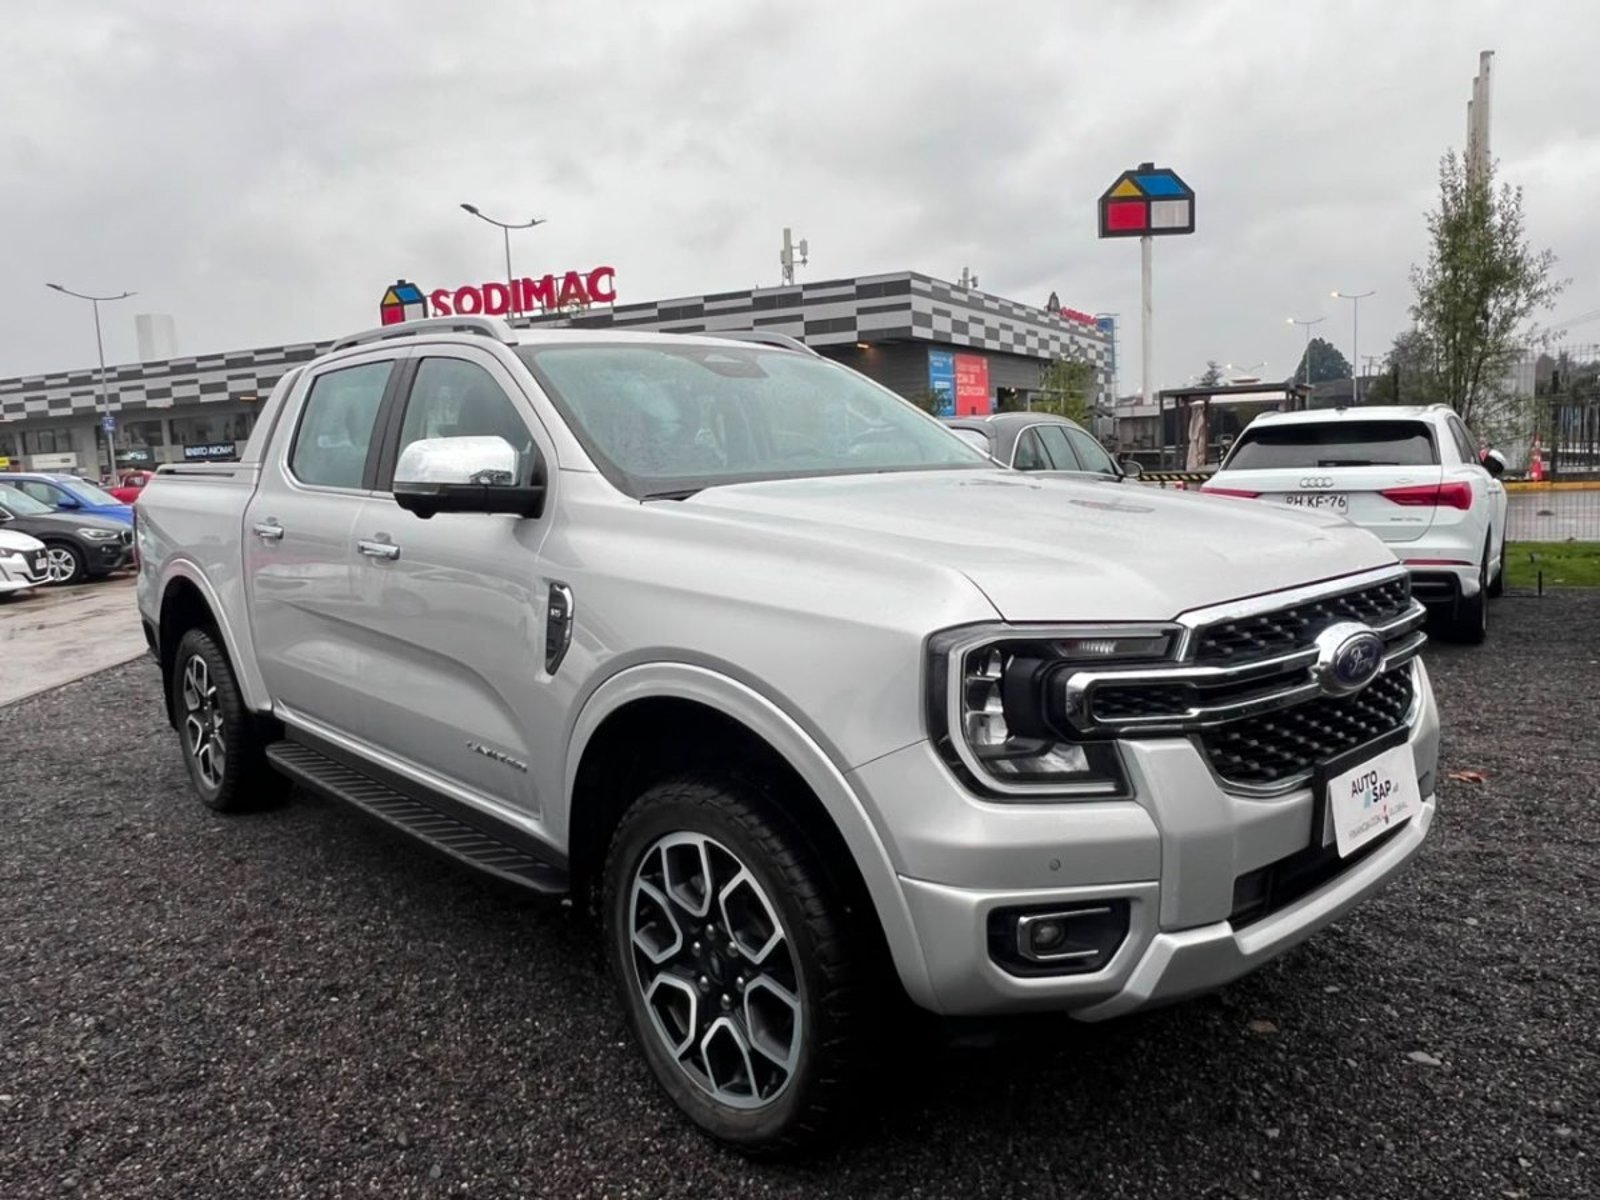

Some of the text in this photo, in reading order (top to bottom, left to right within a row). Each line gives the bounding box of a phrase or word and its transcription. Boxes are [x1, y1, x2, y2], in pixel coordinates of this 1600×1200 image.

[430, 266, 616, 317] SODIMAC
[1351, 770, 1378, 798] AUTO
[1372, 780, 1391, 803] SAP
